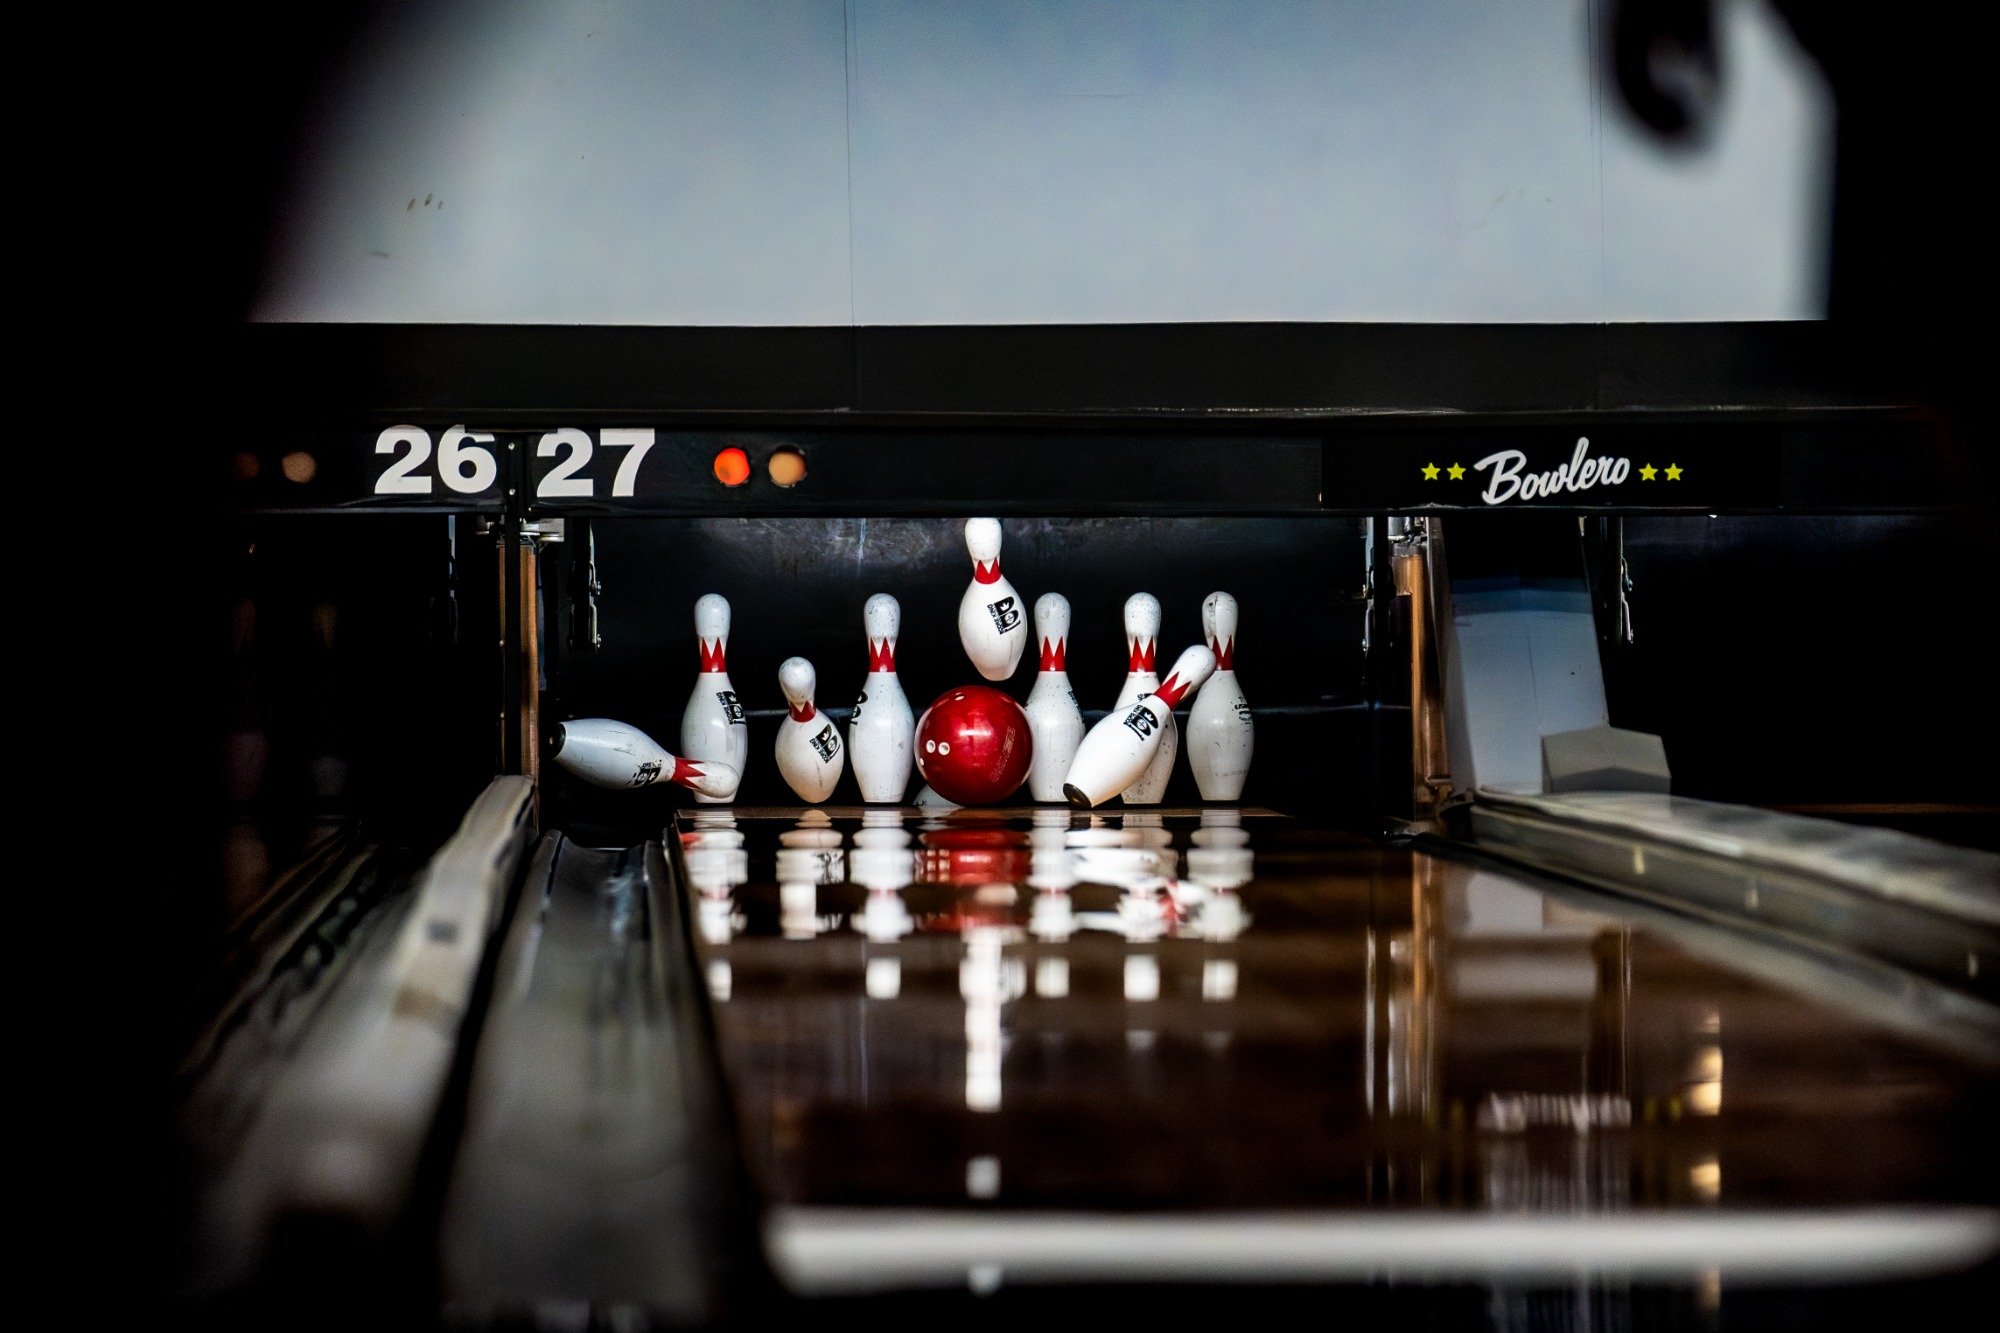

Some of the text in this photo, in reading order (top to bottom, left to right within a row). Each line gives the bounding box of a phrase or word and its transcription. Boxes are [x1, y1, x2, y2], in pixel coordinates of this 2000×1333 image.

[374, 424, 497, 495] 26
[536, 427, 656, 498] 27
[1473, 437, 1631, 505] Bowlero
